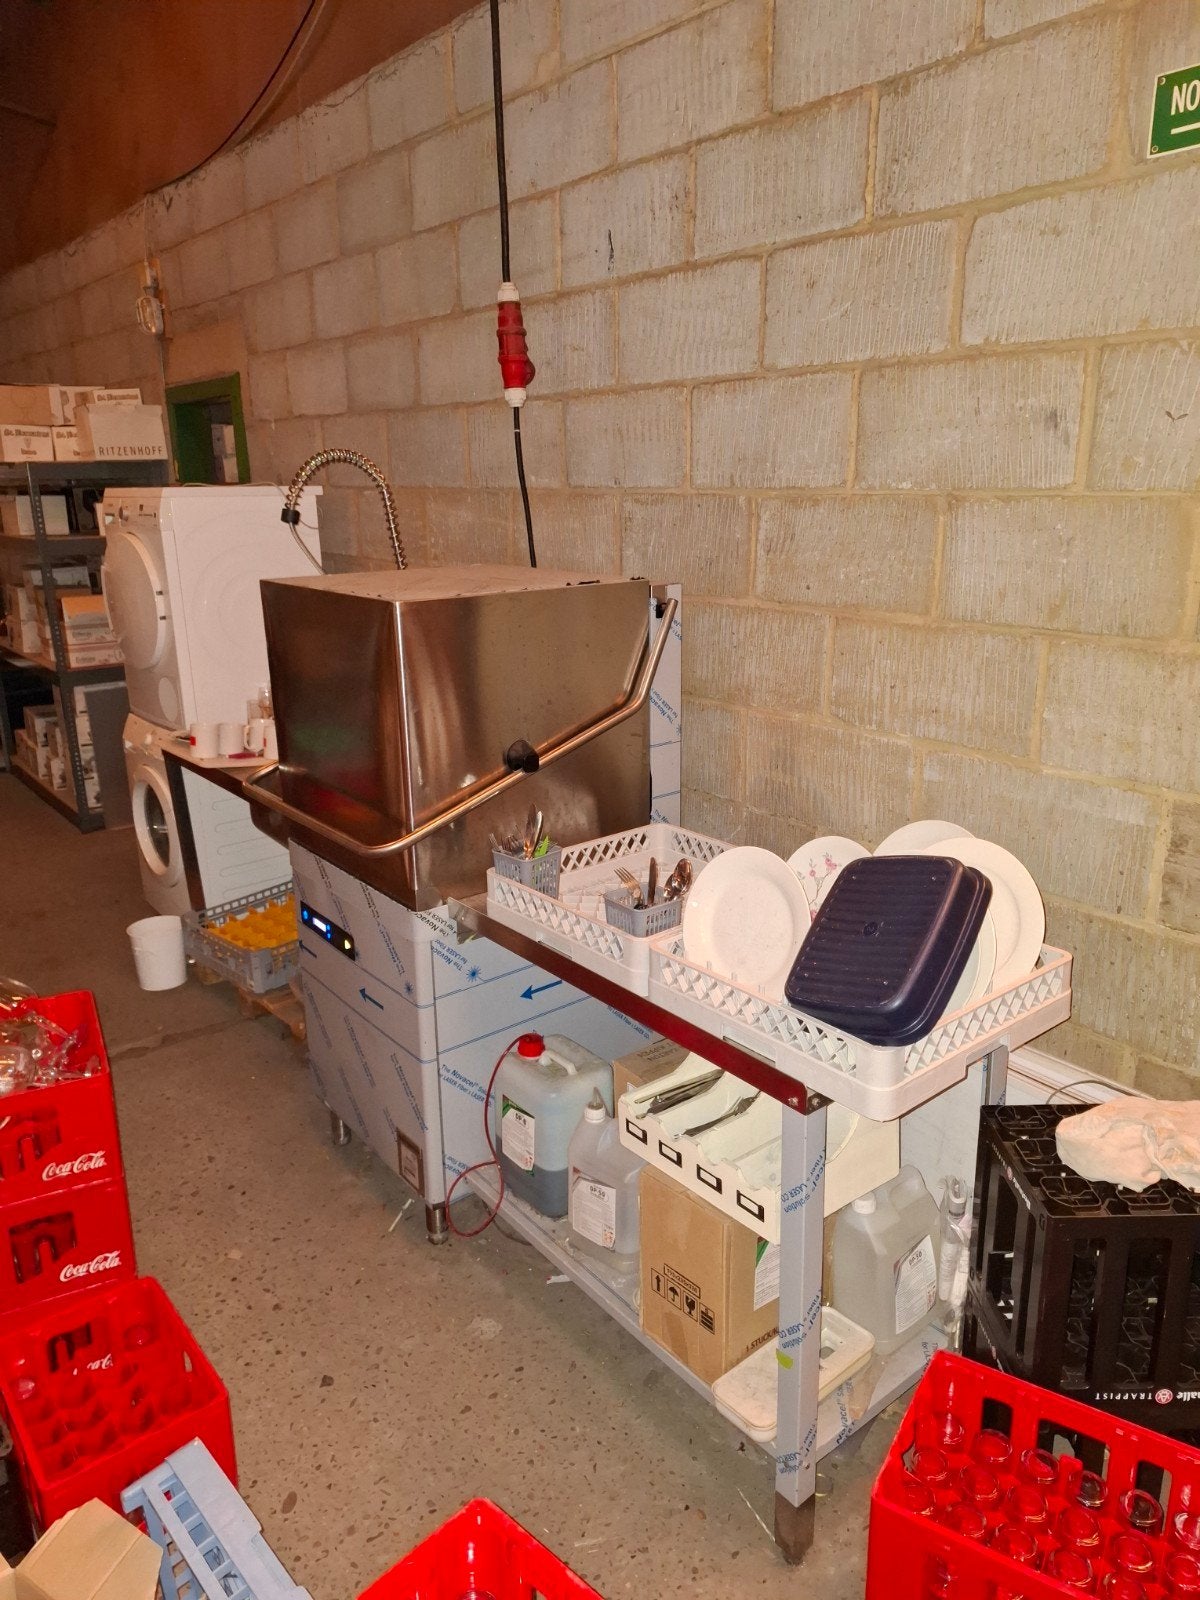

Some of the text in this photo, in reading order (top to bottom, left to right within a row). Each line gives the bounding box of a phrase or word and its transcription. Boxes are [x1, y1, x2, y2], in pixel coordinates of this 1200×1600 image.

[1171, 80, 1200, 115] NO
[99, 446, 162, 456] RITZENHOFF
[42, 1150, 107, 1181] Coca-Cola
[59, 1250, 121, 1282] Coca-Cola
[1095, 1391, 1200, 1402] TRAPPIST alle
